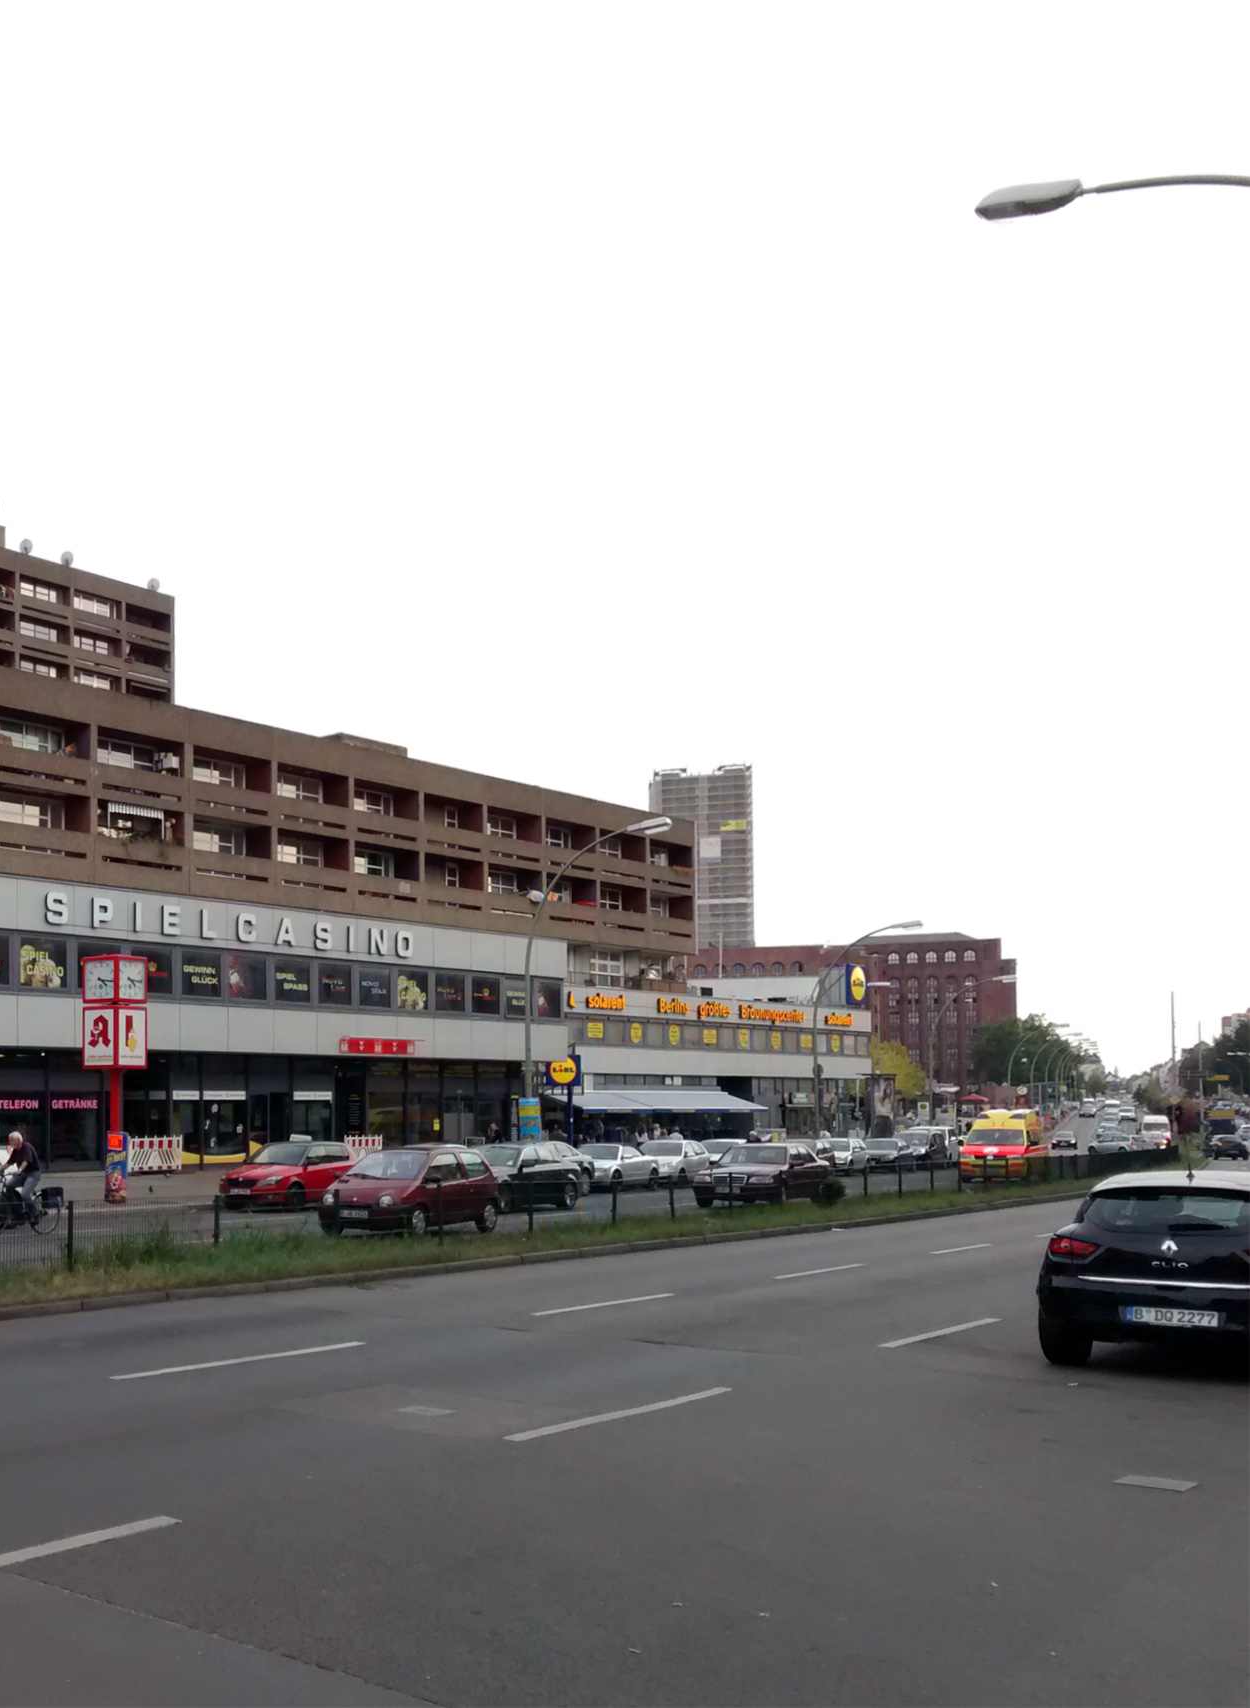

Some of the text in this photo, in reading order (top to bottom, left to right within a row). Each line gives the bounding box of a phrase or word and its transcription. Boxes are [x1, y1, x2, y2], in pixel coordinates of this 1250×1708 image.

[45, 891, 414, 958] SPIELCASINO
[22, 949, 49, 961] SPIEL
[26, 964, 64, 977] CASINO
[183, 964, 216, 975] GEWINN
[191, 975, 218, 985] GLÜCK
[276, 972, 296, 981] SPIEL
[283, 982, 308, 991] SPASS
[586, 993, 626, 1010] solarent
[657, 997, 690, 1014] Berlins
[51, 1098, 98, 1110] GETRÄNKE
[1134, 1308, 1144, 1320] B
[1177, 1311, 1216, 1325] 2277
